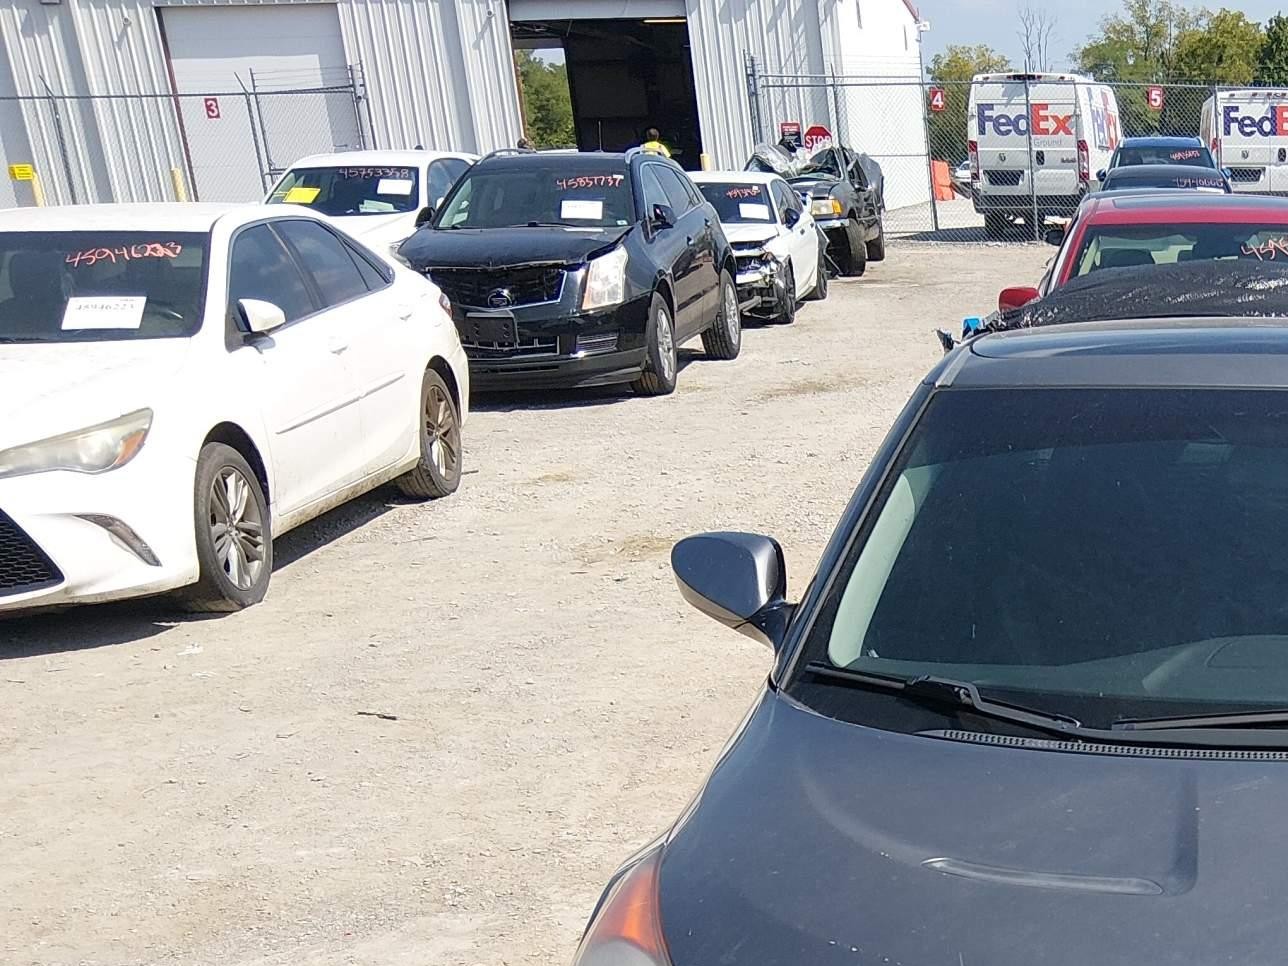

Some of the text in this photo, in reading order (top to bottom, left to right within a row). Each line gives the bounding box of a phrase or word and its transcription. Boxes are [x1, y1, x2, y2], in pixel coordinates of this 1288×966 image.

[931, 92, 943, 108] 4
[1151, 89, 1161, 107] 5
[207, 100, 218, 116] 3
[977, 103, 1073, 136] FedEx
